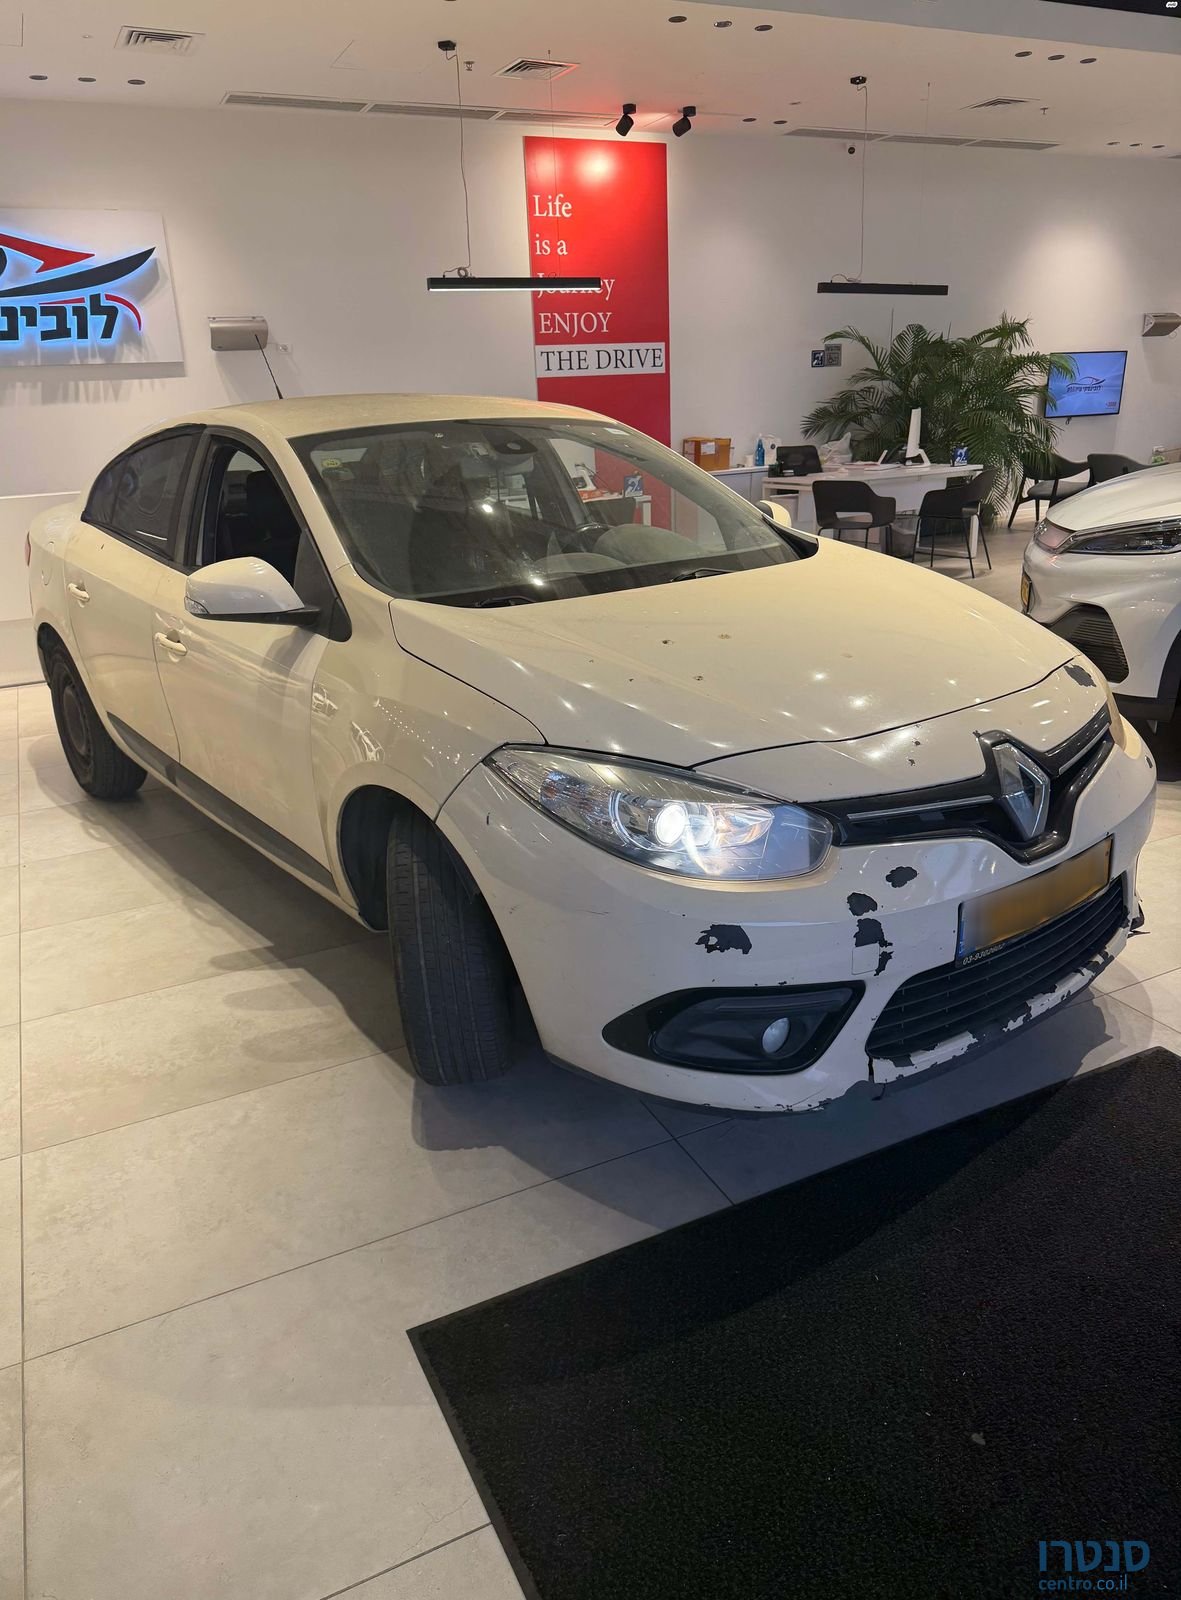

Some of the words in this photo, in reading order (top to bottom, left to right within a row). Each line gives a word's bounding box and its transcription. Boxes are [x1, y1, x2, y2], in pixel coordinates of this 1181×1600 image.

[533, 193, 573, 217] Life
[535, 233, 551, 255] is
[556, 240, 568, 255] a
[539, 311, 613, 338] ENJOY
[540, 350, 590, 371] THE
[595, 347, 664, 370] DRIVE
